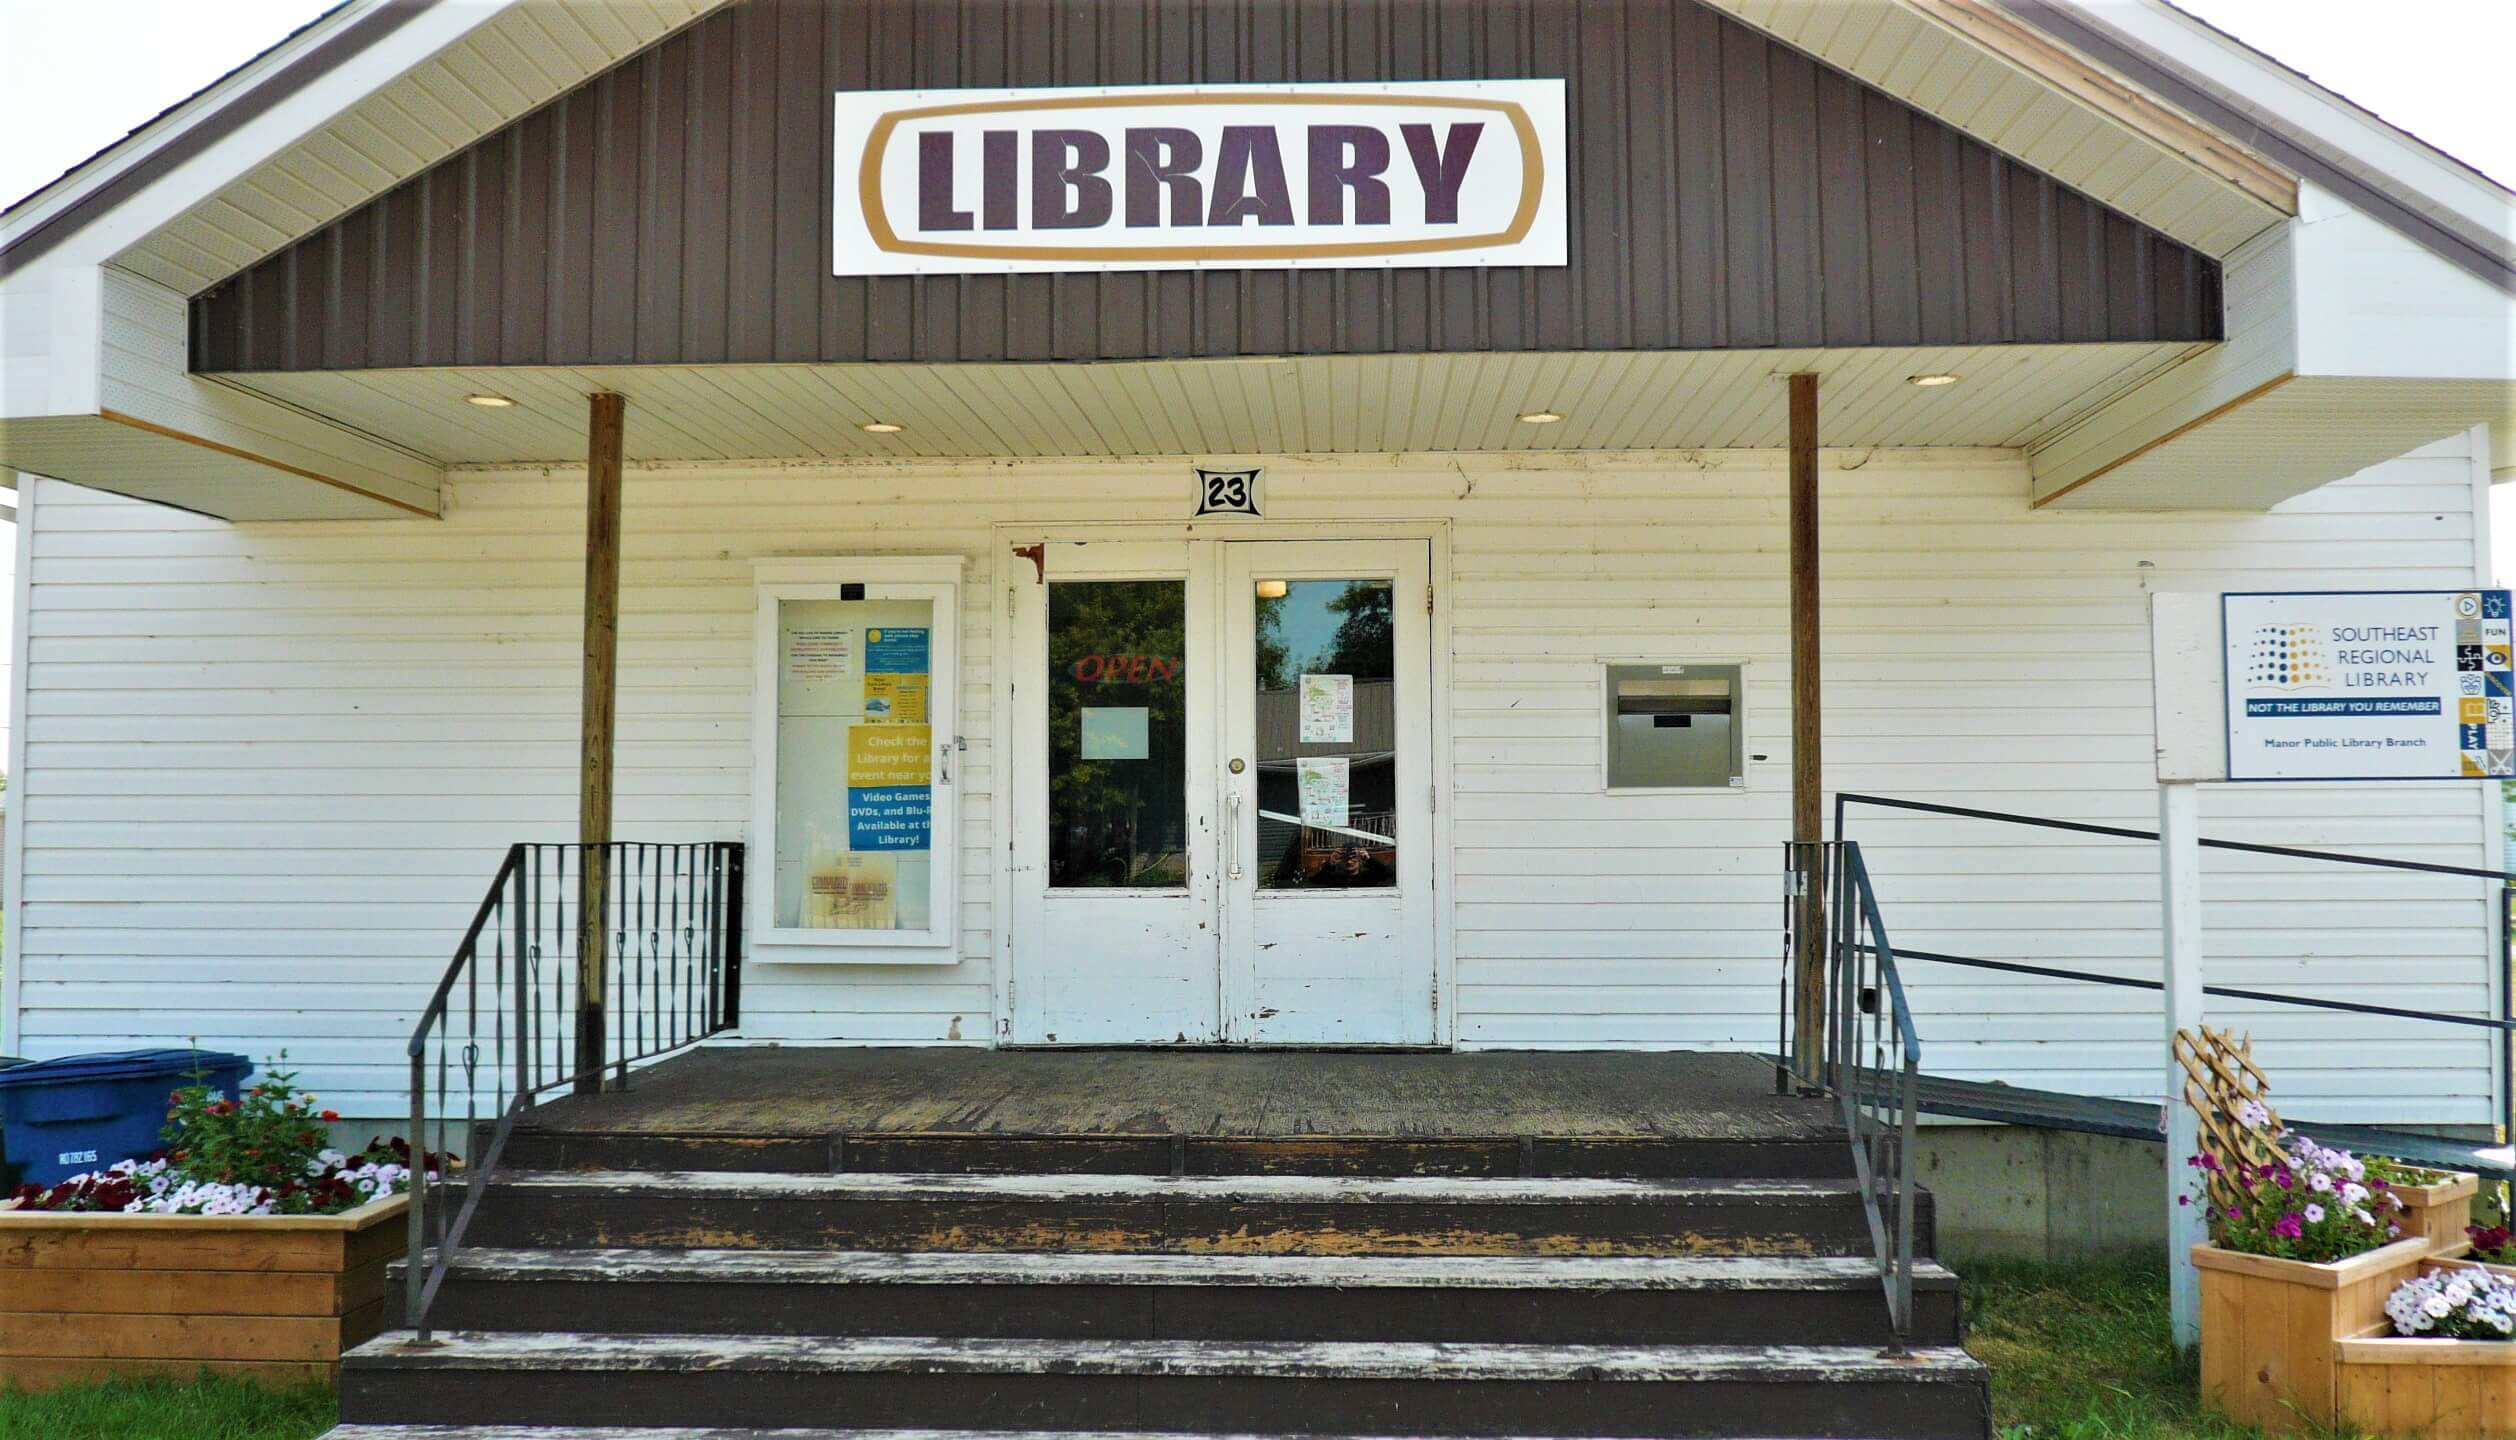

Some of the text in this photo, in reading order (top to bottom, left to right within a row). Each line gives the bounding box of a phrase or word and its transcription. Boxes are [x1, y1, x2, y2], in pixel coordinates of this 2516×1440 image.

[918, 122, 1486, 231] LIBRARY
[1208, 476, 1247, 507] 23
[2332, 626, 2440, 642] SOUTHEAST
[2485, 628, 2506, 636] FUN
[2338, 649, 2435, 665] REGIONAL
[1074, 655, 1178, 683] OPEN
[2345, 672, 2428, 687] LIBRARY
[2249, 701, 2440, 713] NOT THE LIBRARY YOU REMEMBER
[868, 736, 929, 746] Check the
[2467, 723, 2479, 750] PLAY
[2265, 738, 2427, 749] Manor Public Library Branch
[857, 752, 899, 765] Library
[902, 752, 920, 763] for
[850, 771, 885, 780] event
[888, 771, 913, 780] near
[862, 792, 893, 802] Video
[851, 808, 881, 817] DVDs,
[883, 806, 904, 816] and
[857, 821, 906, 831] Available
[908, 822, 921, 830] at
[878, 834, 920, 846] Library!
